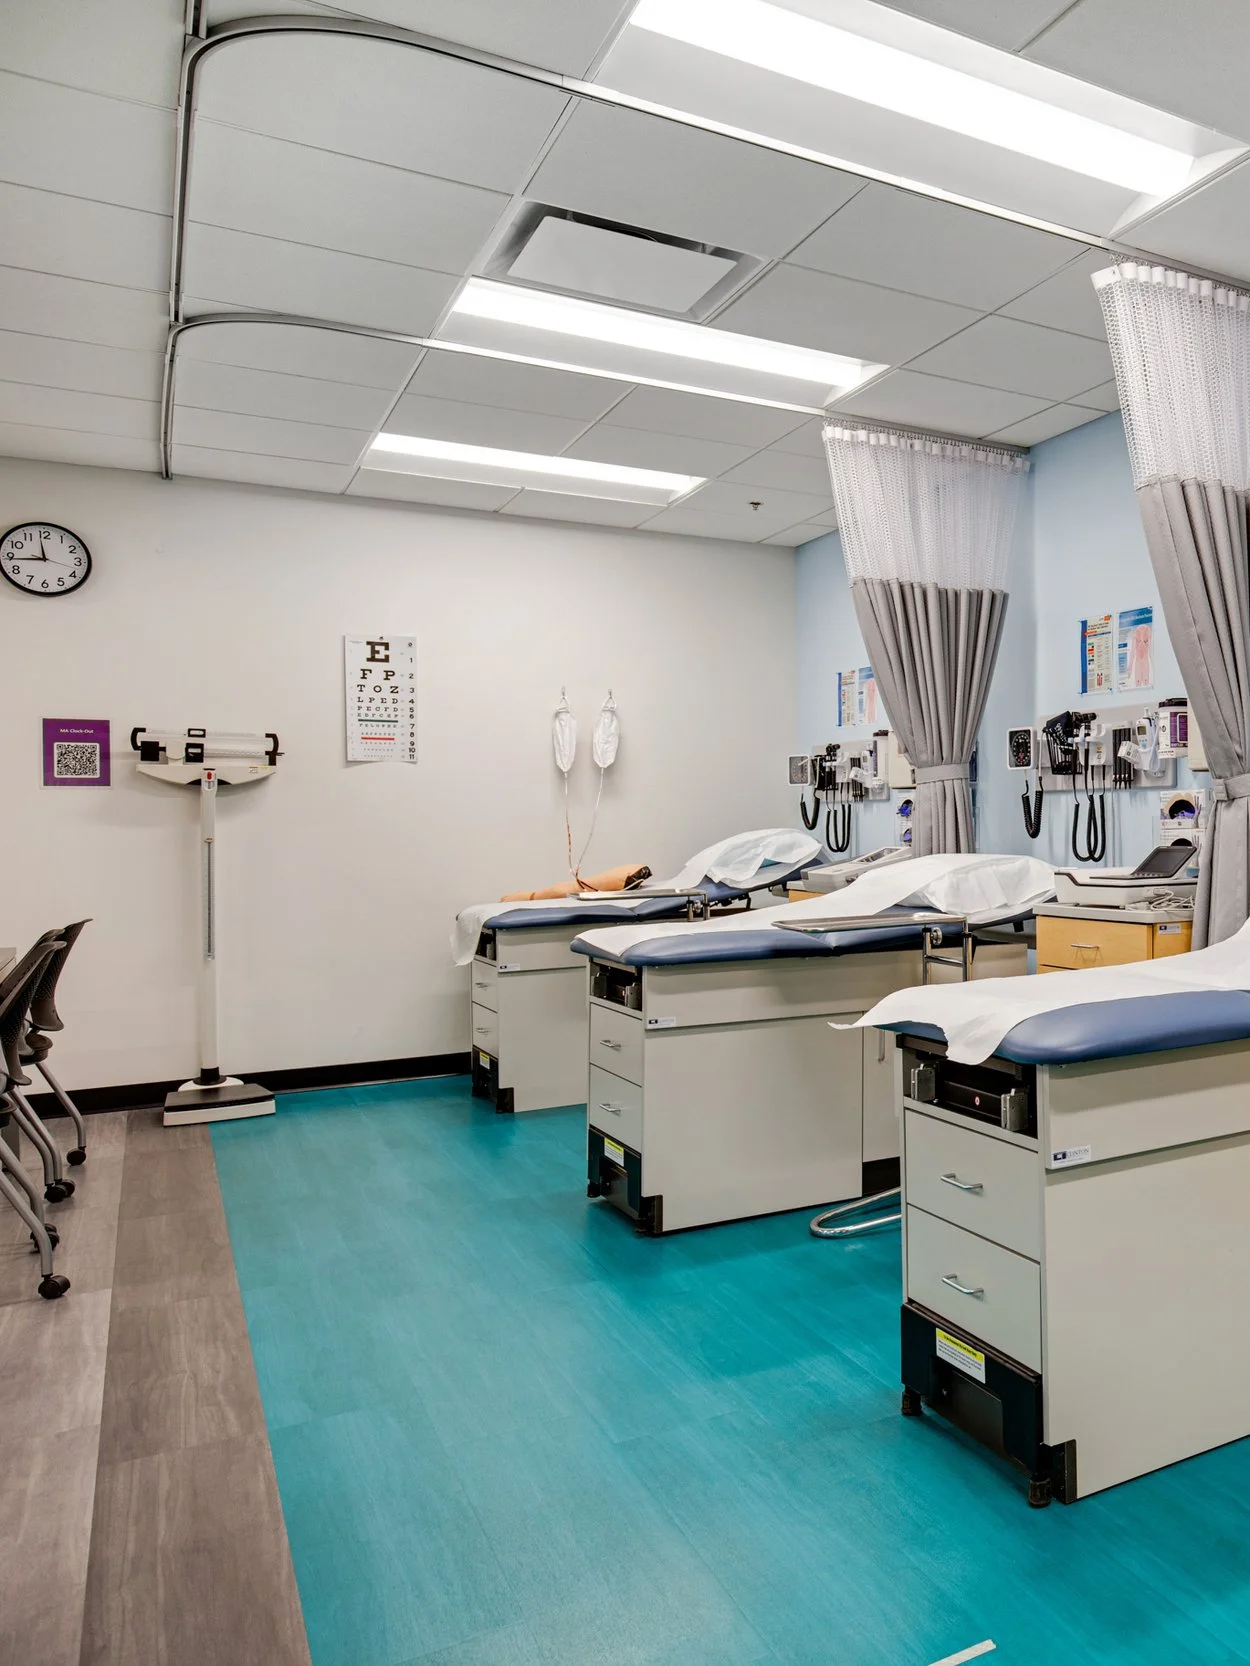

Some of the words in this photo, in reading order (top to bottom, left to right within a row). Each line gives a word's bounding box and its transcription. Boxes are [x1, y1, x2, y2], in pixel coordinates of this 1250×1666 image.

[23, 532, 33, 542] 11
[60, 535, 64, 544] 1
[10, 540, 24, 550] 10
[68, 545, 77, 554] 2
[6, 552, 15, 561] 9
[73, 557, 82, 567] 3
[12, 565, 20, 575] 8
[68, 570, 77, 579] 4
[26, 574, 35, 585] 7
[41, 579, 49, 589] 6
[56, 577, 65, 587] 5
[366, 641, 390, 663] E
[360, 668, 372, 680] F
[383, 670, 396, 681] P
[357, 684, 366, 692] T
[390, 685, 399, 694] Z
